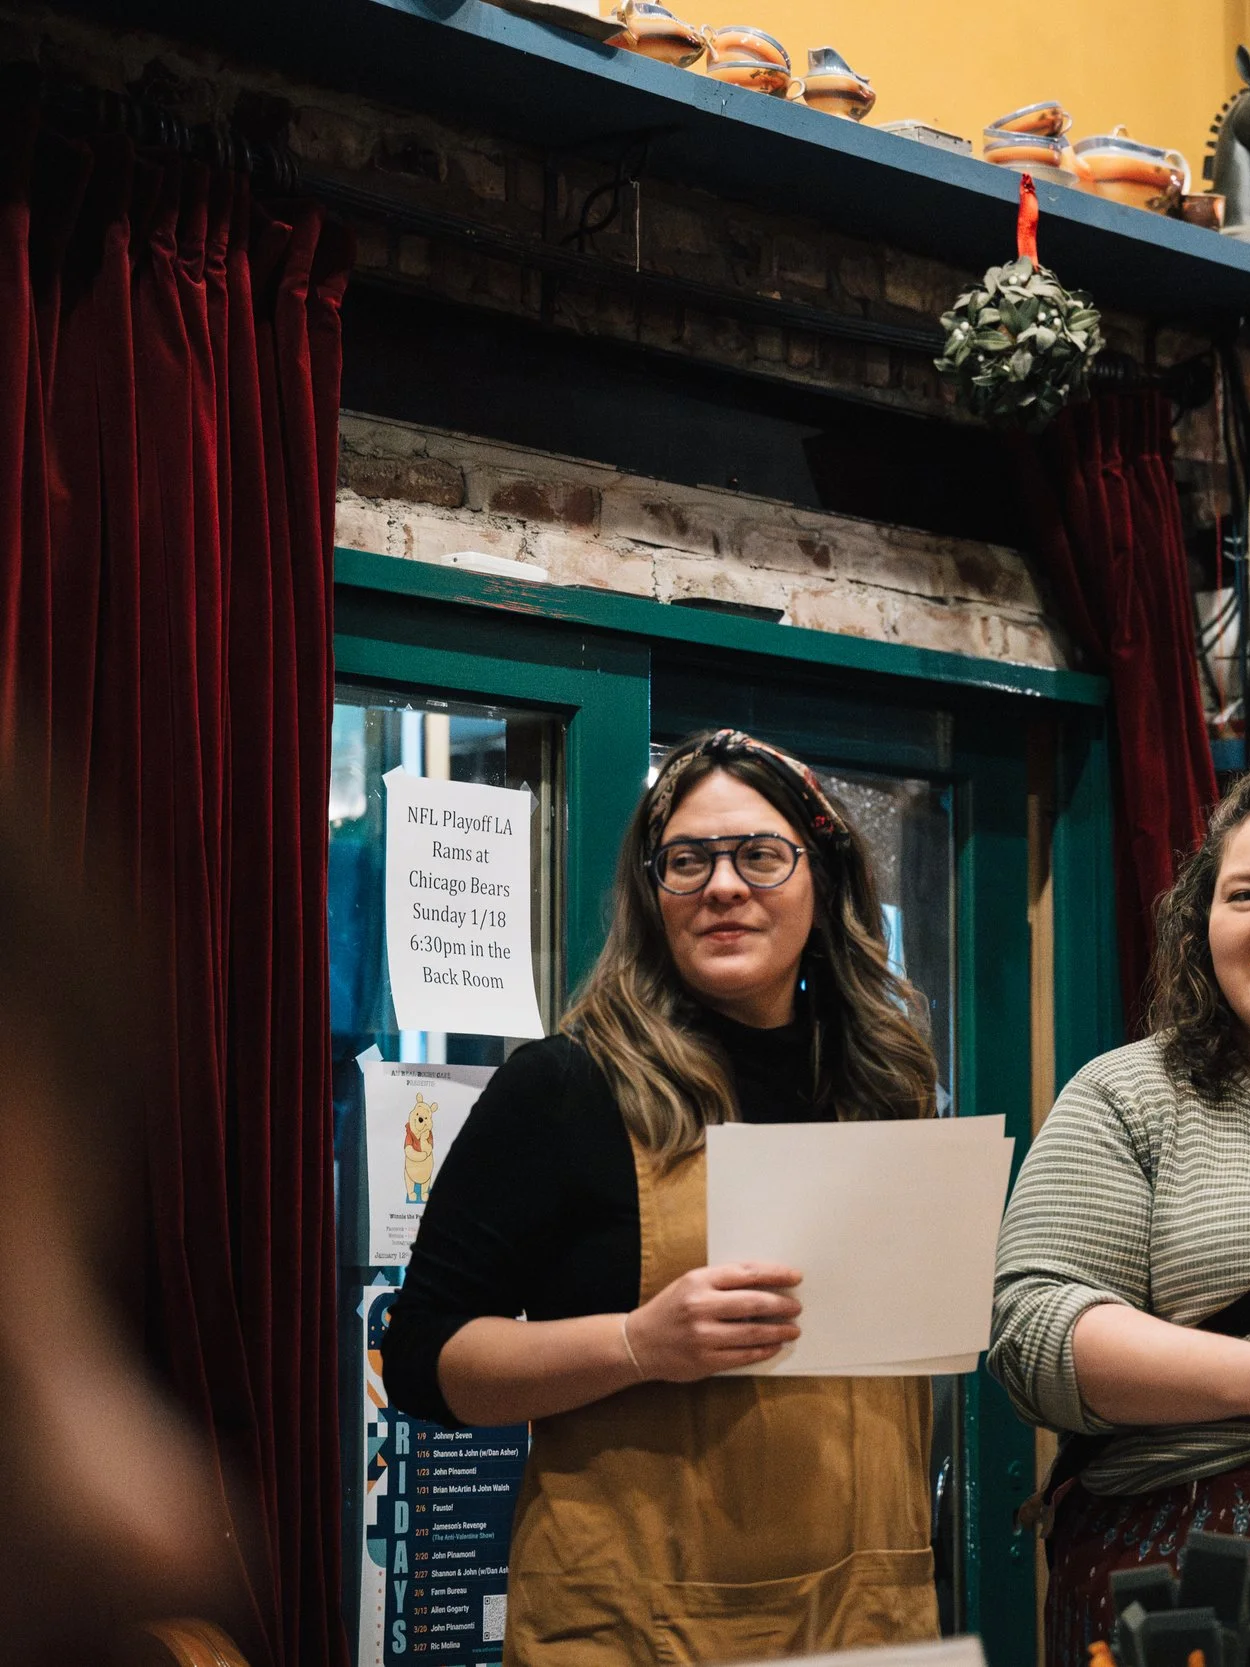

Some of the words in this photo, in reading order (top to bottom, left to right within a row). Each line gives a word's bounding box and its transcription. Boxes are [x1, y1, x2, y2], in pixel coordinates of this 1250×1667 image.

[407, 806, 438, 826] NFL
[442, 810, 493, 834] Playoff
[494, 818, 513, 836] LA
[432, 840, 472, 862] Rams
[475, 849, 490, 863] at
[409, 870, 466, 896] Chicago
[470, 877, 510, 897] Bears
[412, 903, 466, 928] Sunday
[471, 909, 506, 930] 1/18
[410, 934, 466, 958] 6:30pm
[470, 940, 484, 957] in
[488, 941, 511, 959] the
[423, 966, 459, 986] Back
[462, 970, 504, 989] Room
[417, 1432, 426, 1440] 1/9
[433, 1432, 454, 1440] Johnny
[433, 1450, 458, 1458] Shannon
[500, 1448, 518, 1456] Asher)
[448, 1467, 477, 1475] Pinamonti
[416, 1486, 429, 1494] 1/31
[433, 1486, 448, 1494] Brian
[492, 1484, 510, 1492] Walsh
[416, 1504, 426, 1512] 2/6
[432, 1522, 462, 1530] Jameson's
[463, 1522, 486, 1530] Revenge
[391, 1410, 410, 1654] RIDAYS
[416, 1528, 428, 1536] 2/13
[415, 1552, 428, 1560] 2/20
[432, 1552, 446, 1560] John
[447, 1550, 476, 1559] Pinamonti
[431, 1570, 456, 1578] Shannon
[431, 1588, 446, 1596] Farm
[447, 1587, 467, 1595] Bureau
[446, 1605, 469, 1613] Gogarty
[446, 1622, 475, 1630] Pinamonti
[441, 1641, 460, 1649] Molina
